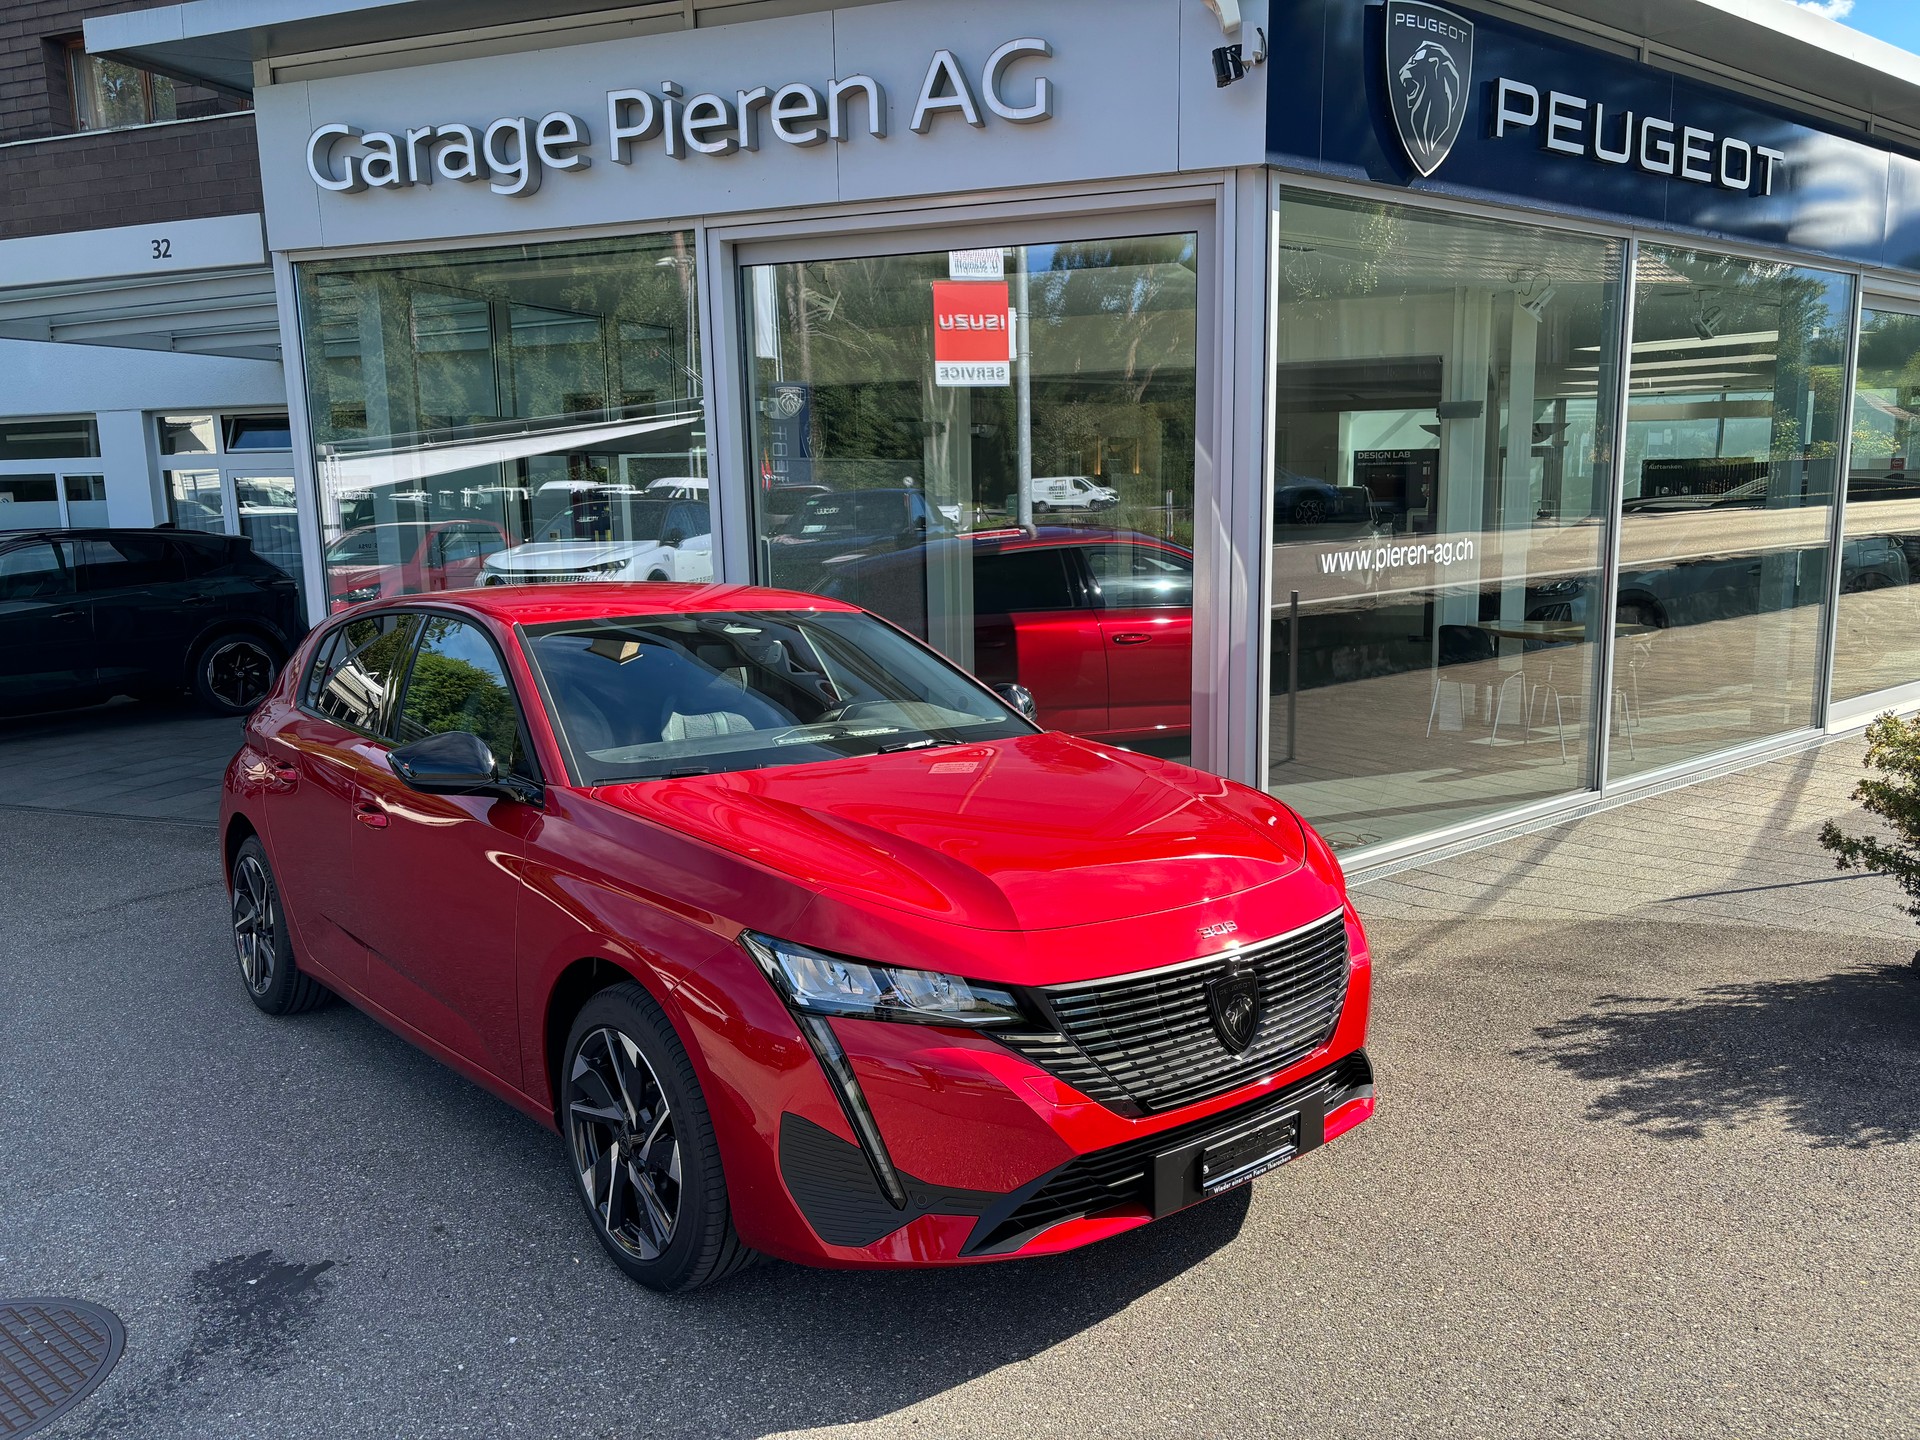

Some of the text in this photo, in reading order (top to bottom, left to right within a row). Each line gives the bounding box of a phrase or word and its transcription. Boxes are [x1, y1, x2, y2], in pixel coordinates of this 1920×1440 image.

[1395, 13, 1467, 43] PEUGEOT
[306, 37, 1053, 198] Garage Pieren AG
[1496, 76, 1785, 197] PEUGEOT
[151, 238, 173, 260] 32
[1357, 451, 1411, 460] DESIGN LAB
[1321, 537, 1474, 574] www.pieren-ag.ch
[1196, 920, 1239, 940] 308
[1213, 1180, 1232, 1195] Wieder
